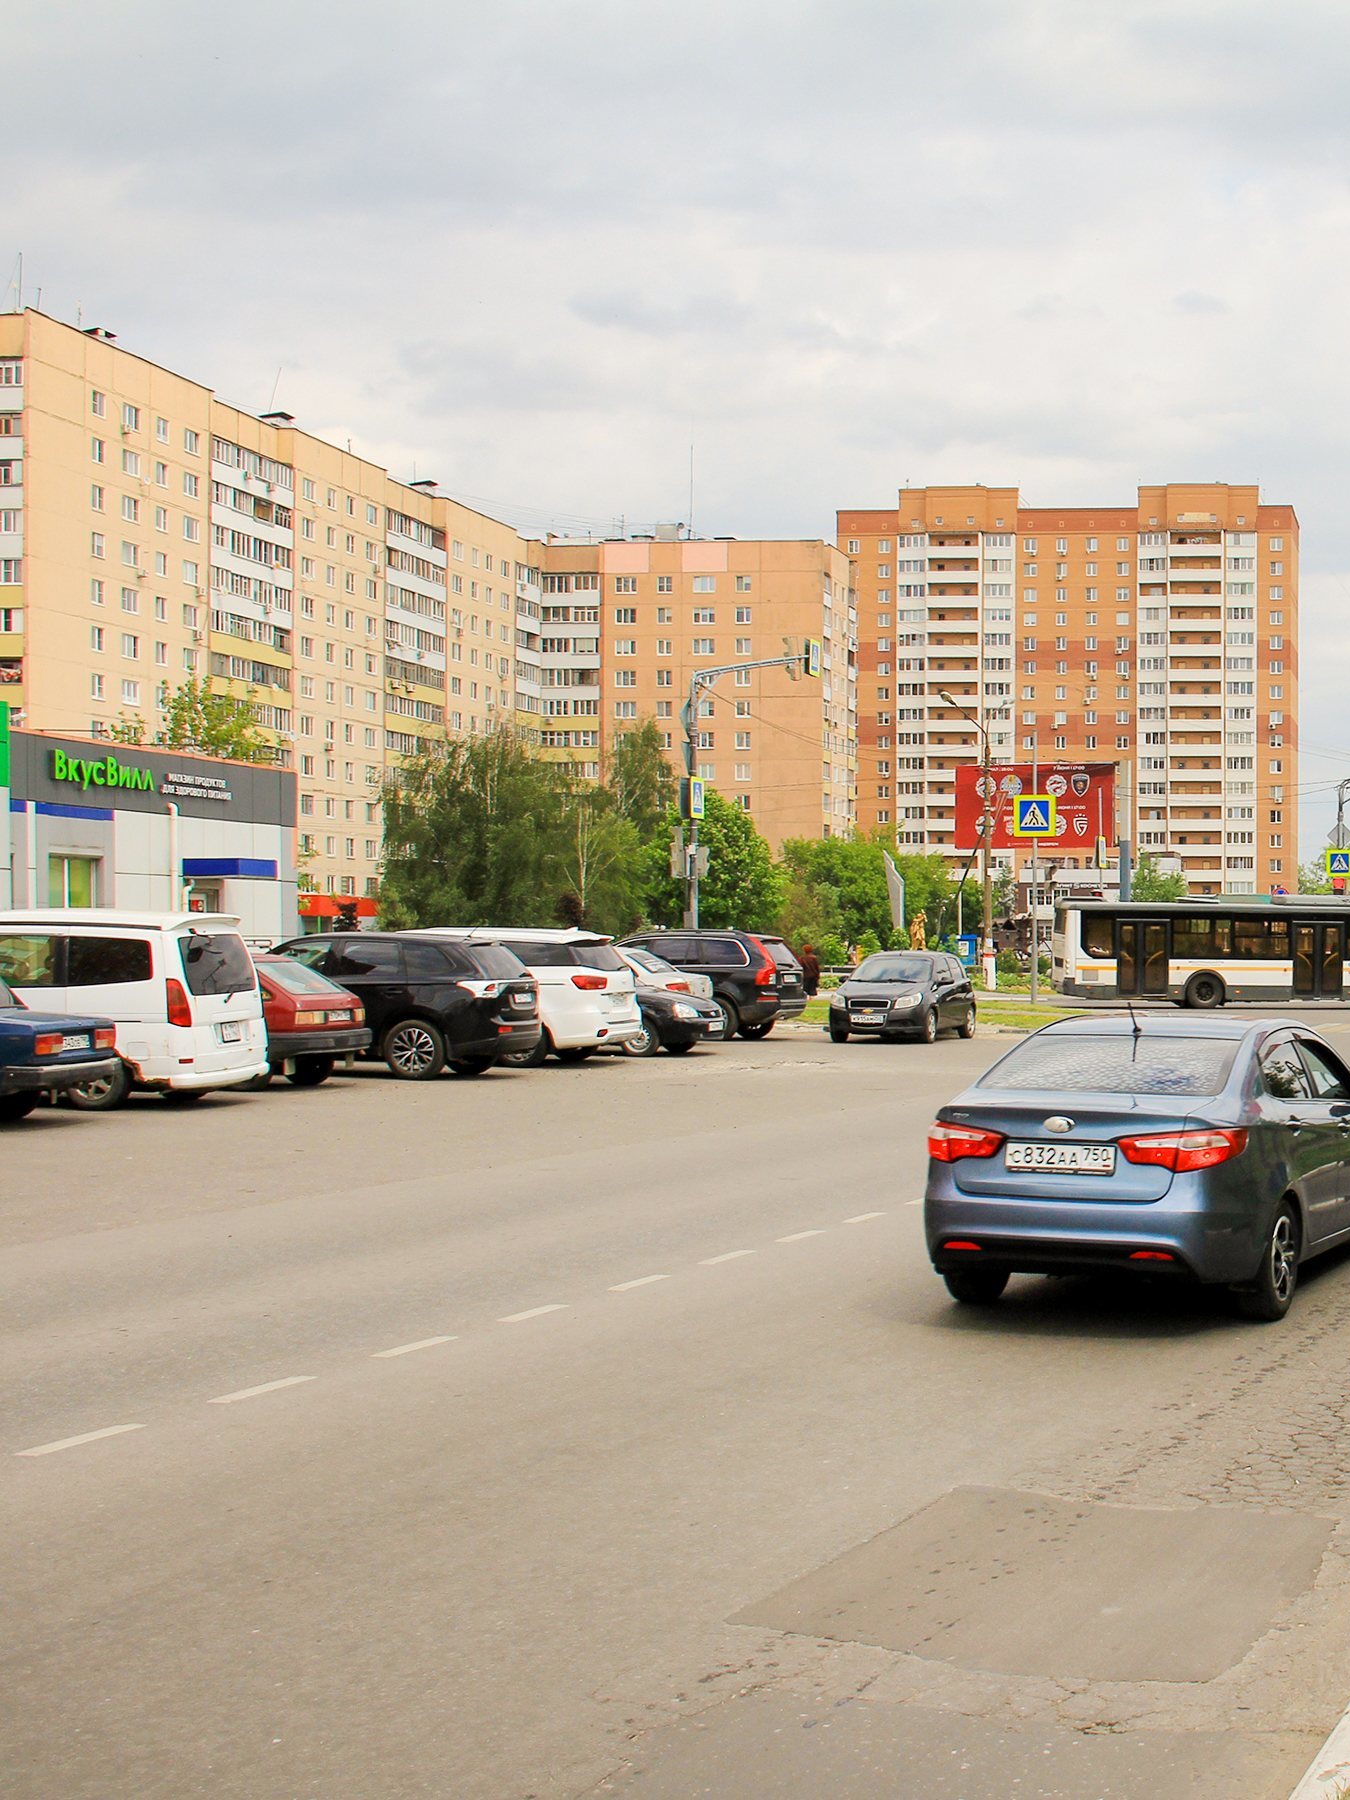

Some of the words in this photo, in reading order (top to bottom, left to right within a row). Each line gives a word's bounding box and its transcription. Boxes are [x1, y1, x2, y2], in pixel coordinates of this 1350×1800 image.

[54, 749, 155, 791] ВкусВилл
[166, 773, 195, 785] МАГАЗИН
[195, 776, 226, 788] ПРОДУКТОВ
[161, 784, 175, 794] ДЛЯ
[175, 786, 207, 798] ЗДОРОВОГО
[207, 789, 232, 800] ПИТАНИЯ
[1012, 1147, 1078, 1166] С832АА
[1083, 1147, 1109, 1161] 750
